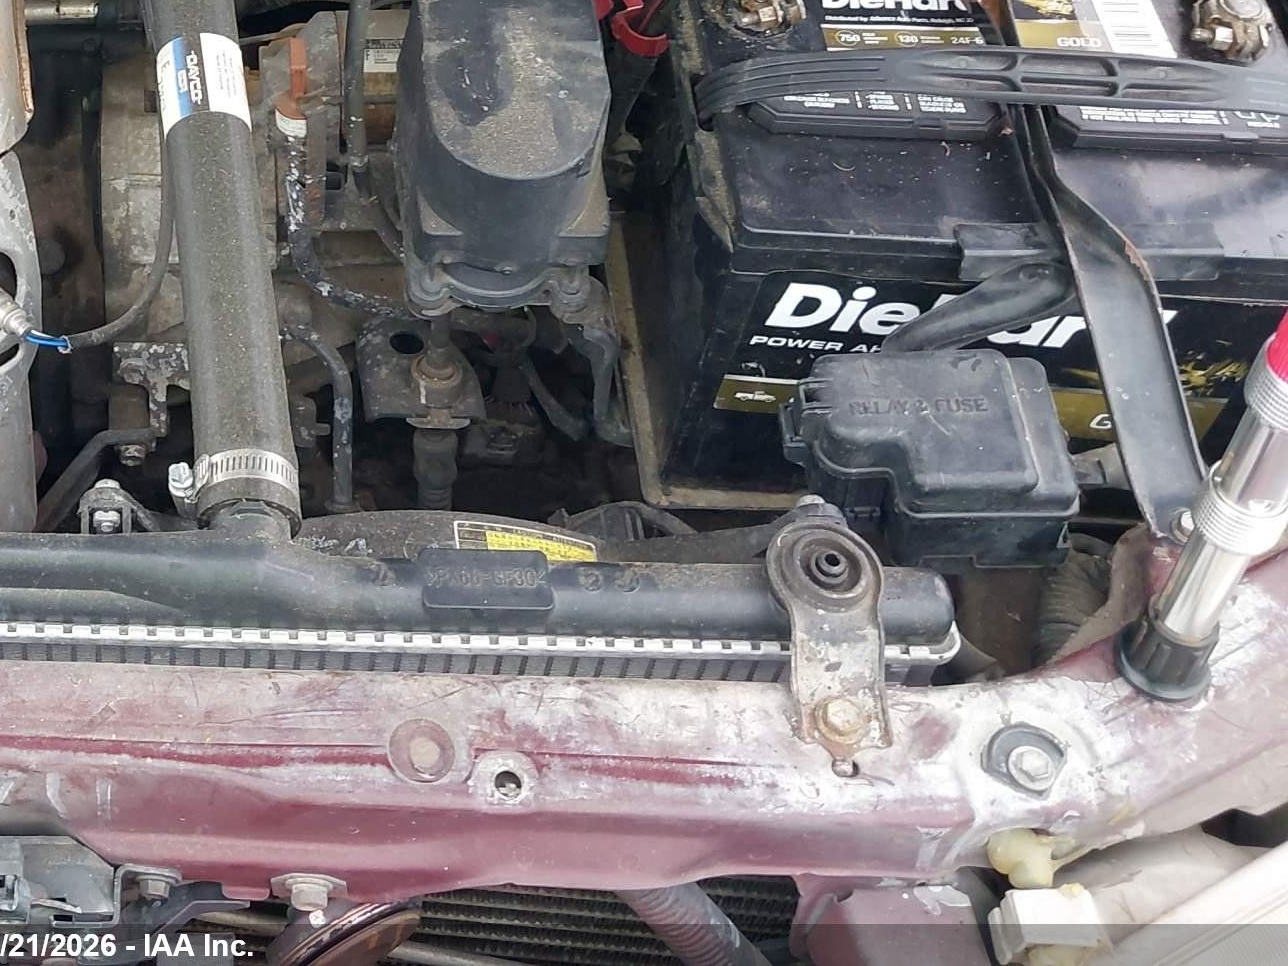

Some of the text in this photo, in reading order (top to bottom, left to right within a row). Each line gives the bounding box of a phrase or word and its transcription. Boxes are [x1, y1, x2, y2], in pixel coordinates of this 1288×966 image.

[839, 33, 861, 43] 750
[1056, 36, 1103, 49] GOLD
[185, 50, 203, 105] DAYCO
[749, 335, 844, 351] POWER
[847, 399, 909, 416] RELAY
[933, 397, 989, 414] FUSE
